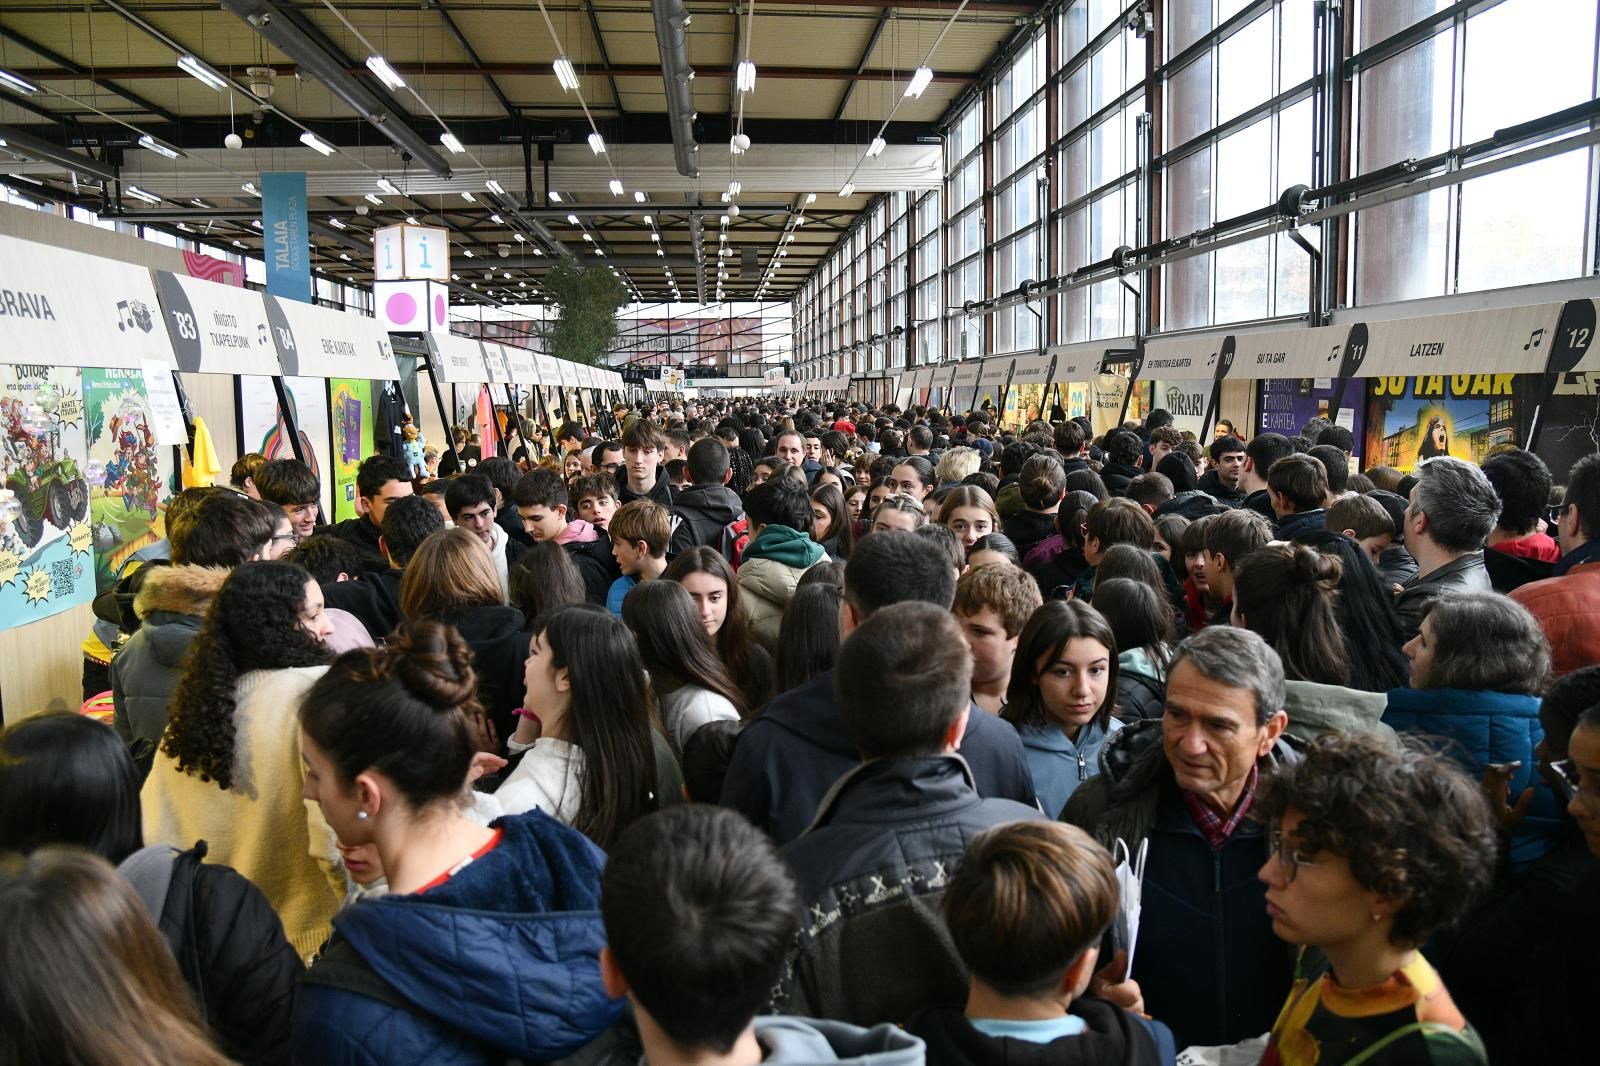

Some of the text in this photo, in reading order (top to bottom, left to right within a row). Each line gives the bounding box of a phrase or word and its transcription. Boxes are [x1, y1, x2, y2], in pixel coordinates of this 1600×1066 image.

[288, 196, 297, 220] PLAZA
[273, 220, 290, 271] TALAIA
[419, 235, 432, 269] i
[209, 332, 251, 349] TXAPELPUNK
[1409, 342, 1445, 357] LATZEN
[1256, 352, 1286, 364] SU TA GAR
[1374, 375, 1516, 396] SU TA GAR
[61, 400, 75, 408] AHATE
[1262, 412, 1296, 430] ELKARTEA
